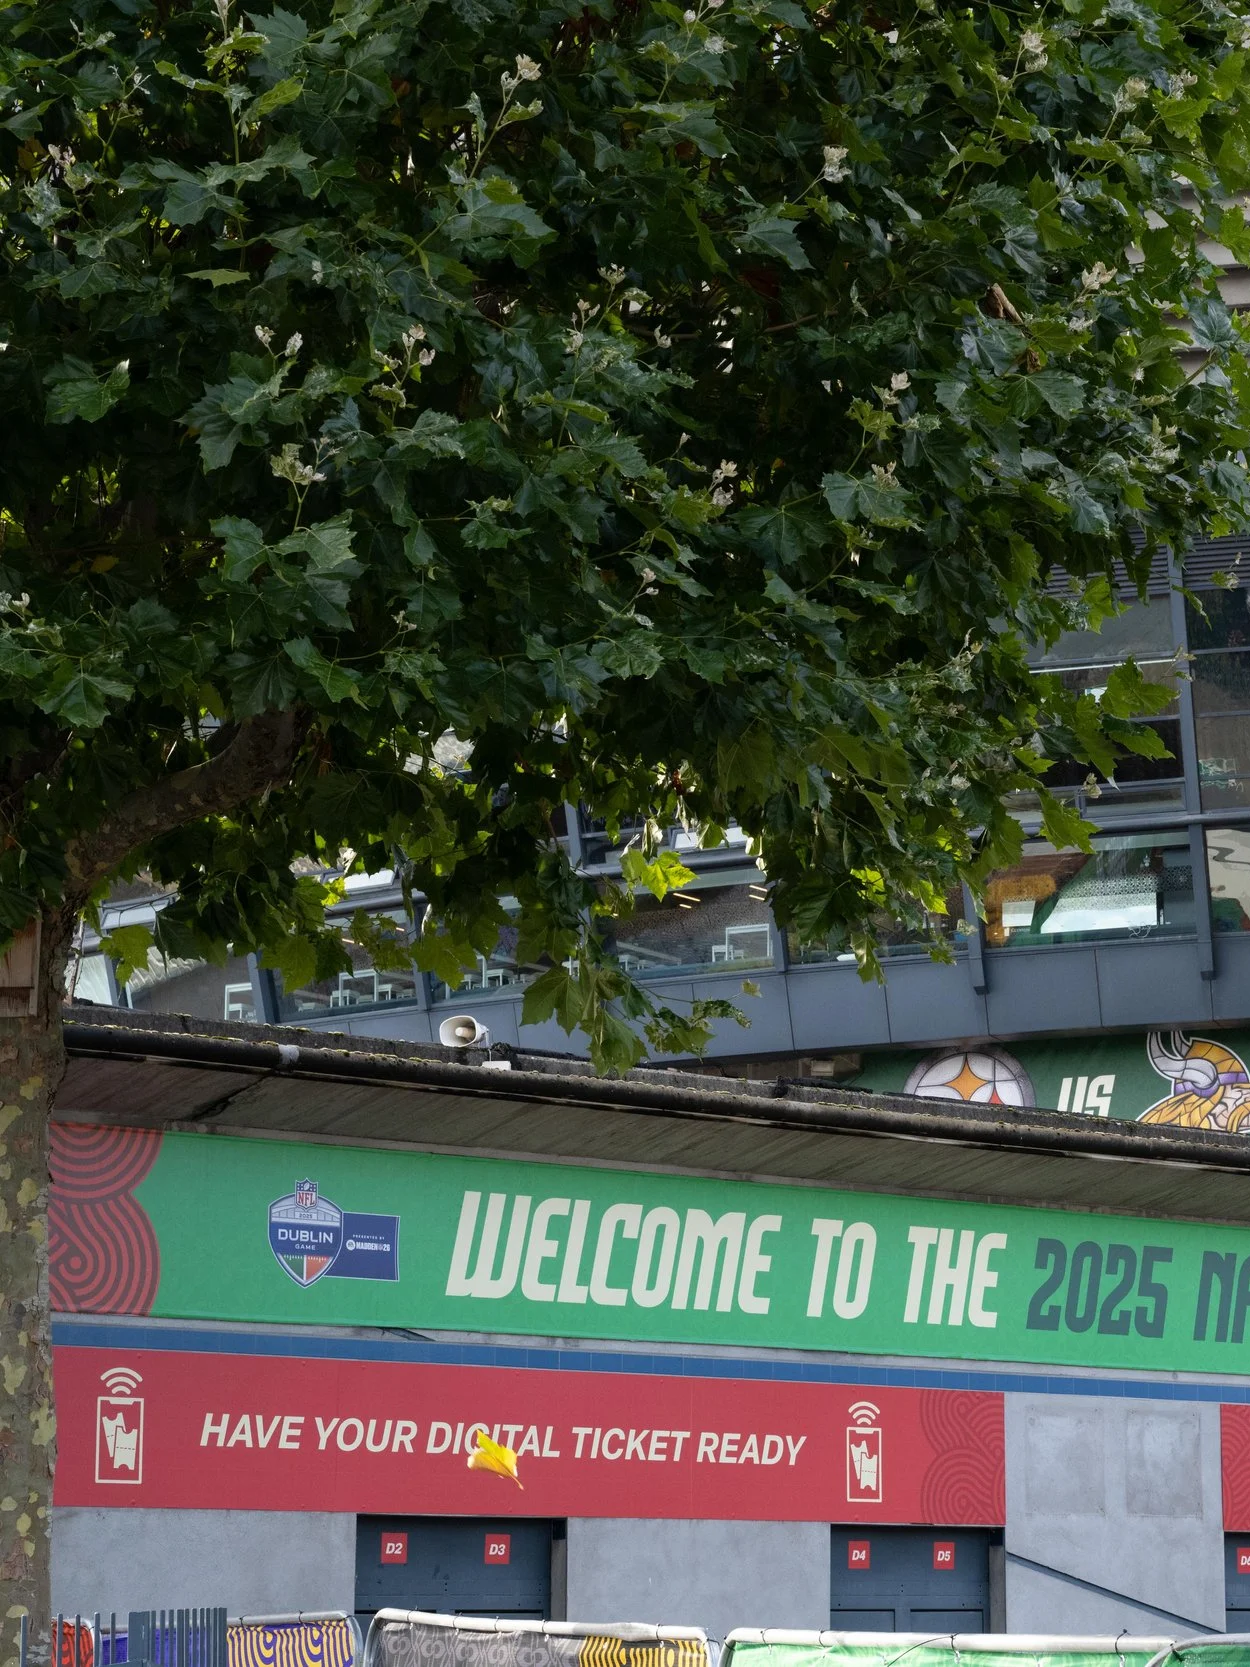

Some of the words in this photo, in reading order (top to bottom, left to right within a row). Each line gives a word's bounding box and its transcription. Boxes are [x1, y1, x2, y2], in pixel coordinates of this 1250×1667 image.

[297, 1191, 316, 1207] NFL
[278, 1228, 333, 1244] DUBLIN
[294, 1243, 316, 1251] GAME
[445, 1191, 782, 1315] WELCOME
[806, 1218, 877, 1320] TO
[903, 1225, 1007, 1328] THE
[1026, 1237, 1174, 1339] 2025
[200, 1412, 305, 1449] HAVE
[314, 1416, 418, 1453] YOUR
[571, 1427, 690, 1462] TICKET
[696, 1431, 807, 1466] READY
[385, 1542, 403, 1554] D2
[488, 1543, 506, 1555] D3
[852, 1549, 866, 1561] D4
[937, 1550, 951, 1561] D5
